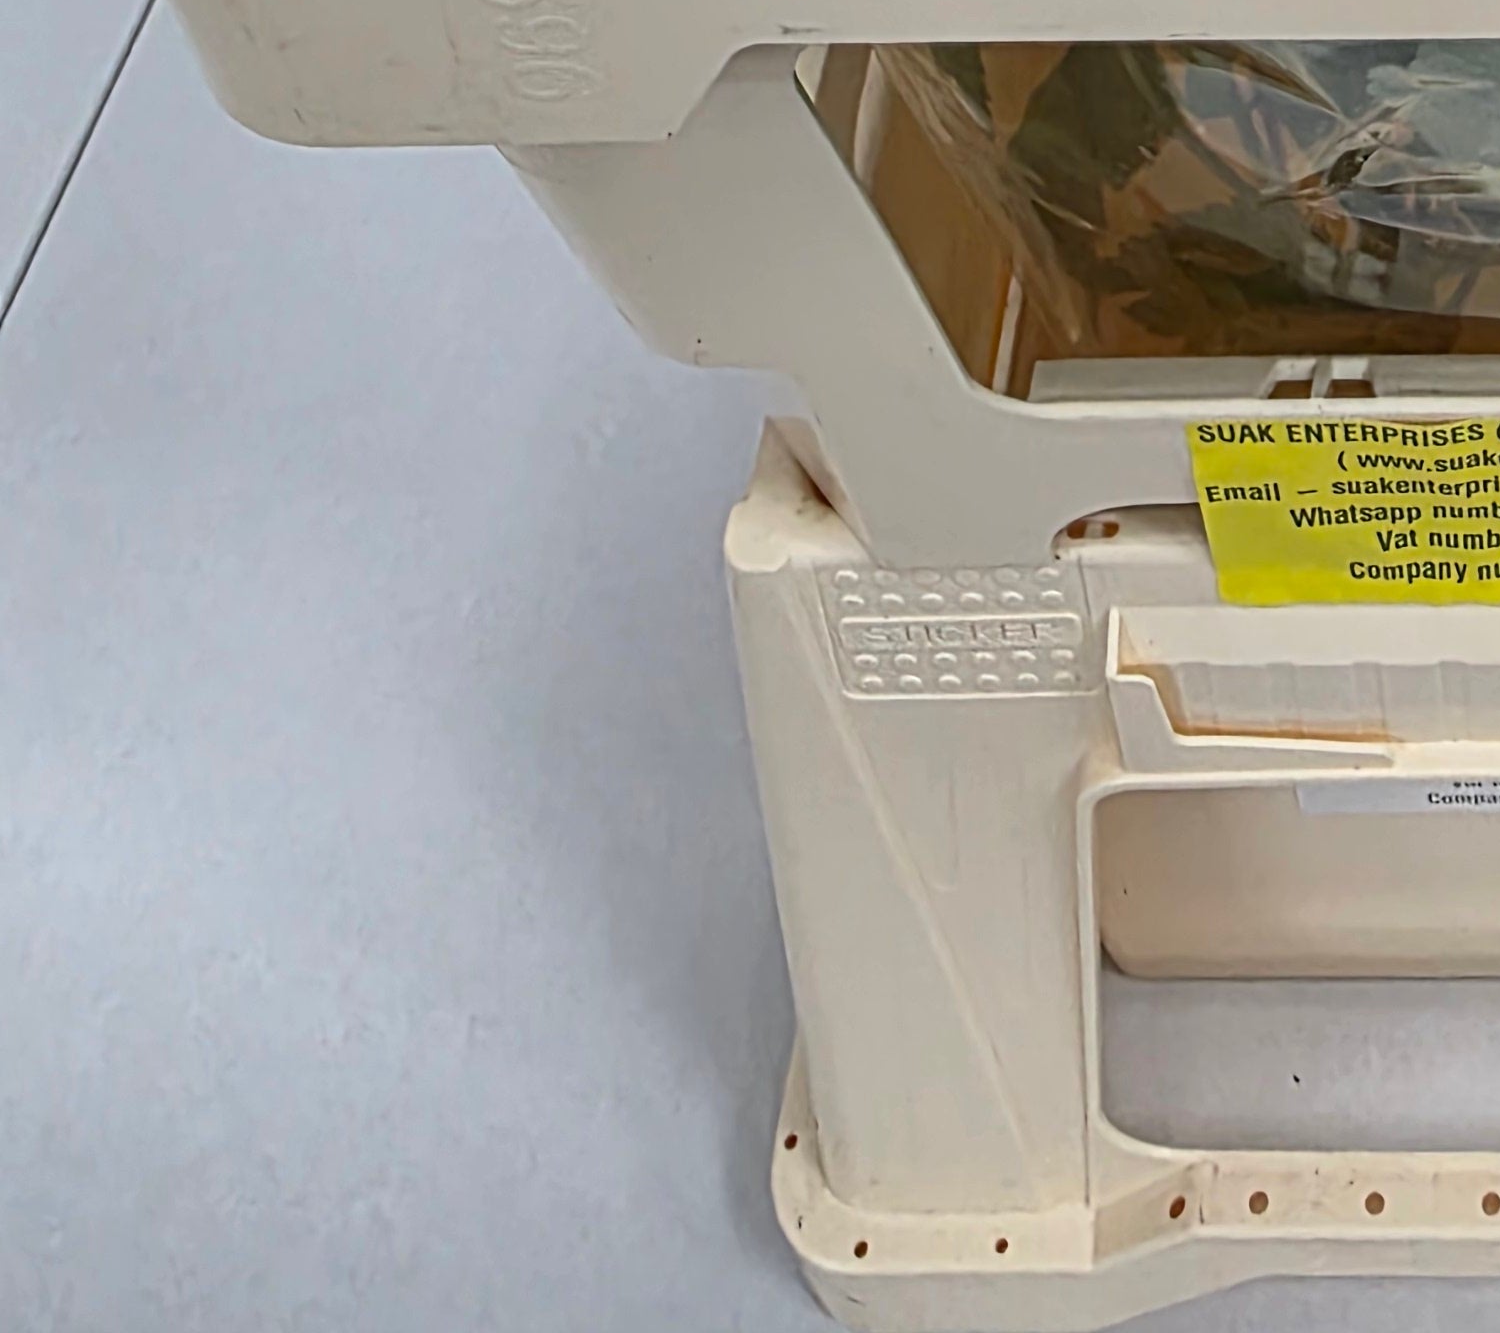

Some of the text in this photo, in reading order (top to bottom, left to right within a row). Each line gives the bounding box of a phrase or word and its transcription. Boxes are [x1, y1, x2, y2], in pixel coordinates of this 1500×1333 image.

[1197, 424, 1276, 444] SUAK
[1286, 423, 1485, 447] ENTERPRISES
[1205, 482, 1281, 503] Email
[1289, 504, 1422, 528] Whatsapp
[1376, 530, 1419, 552] Vat
[1349, 561, 1467, 585] Company
